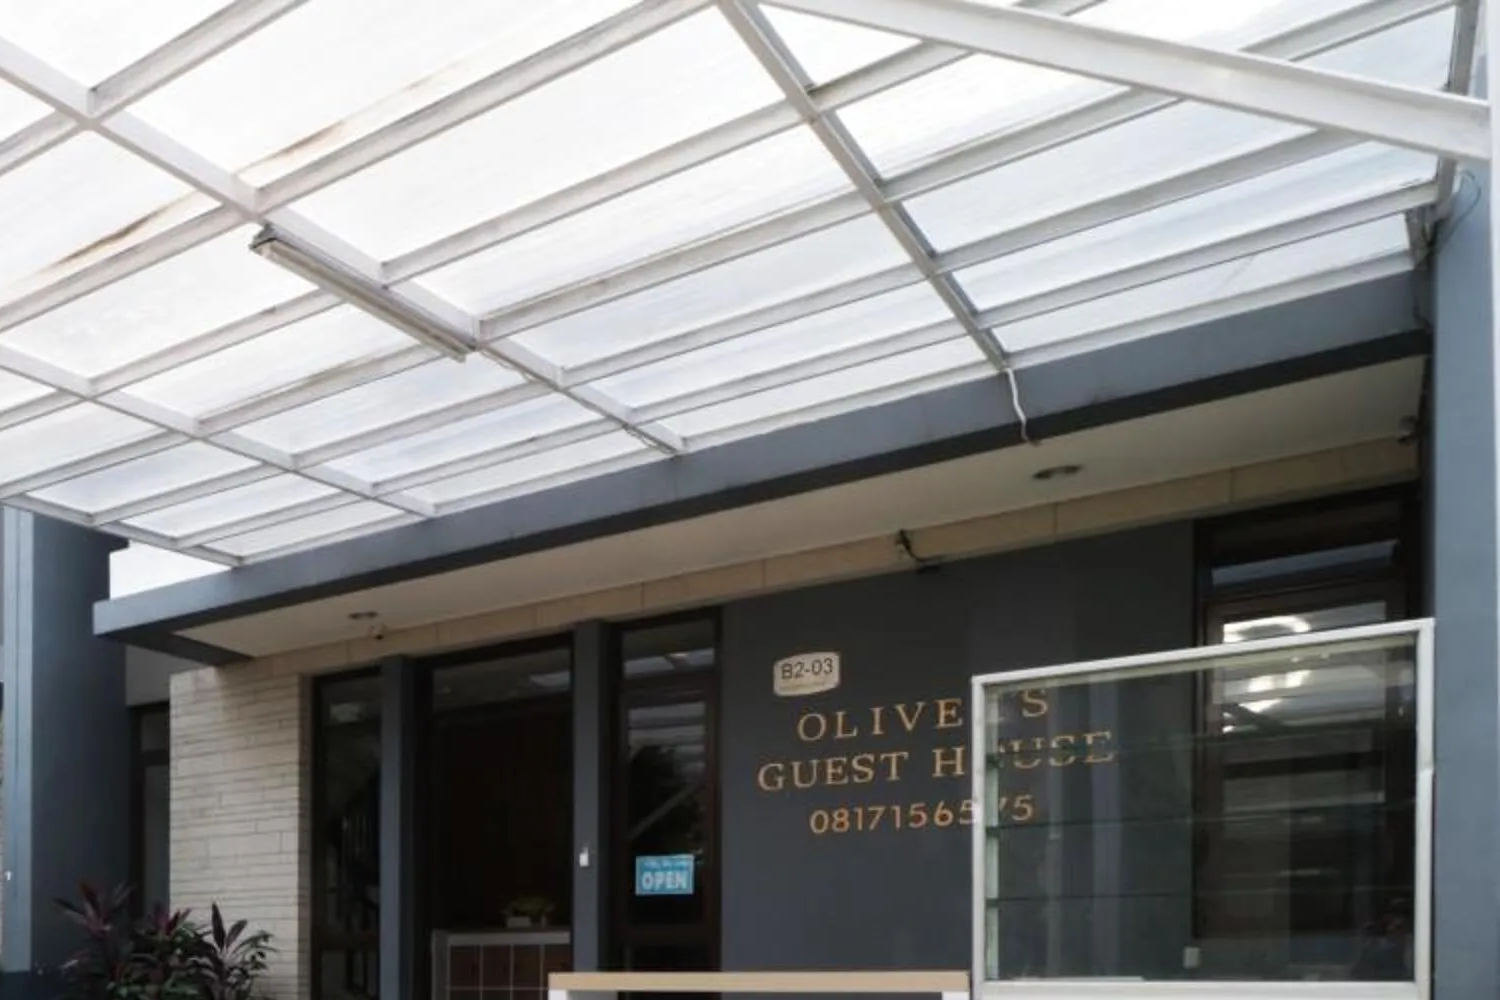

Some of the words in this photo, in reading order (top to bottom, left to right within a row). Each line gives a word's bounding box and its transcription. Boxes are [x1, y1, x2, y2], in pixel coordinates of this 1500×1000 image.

[780, 657, 835, 680] B2-03
[757, 751, 909, 792] GUEST
[932, 731, 1116, 779] HUSE
[809, 795, 1034, 834] 081715655
[641, 870, 689, 891] OPEN
